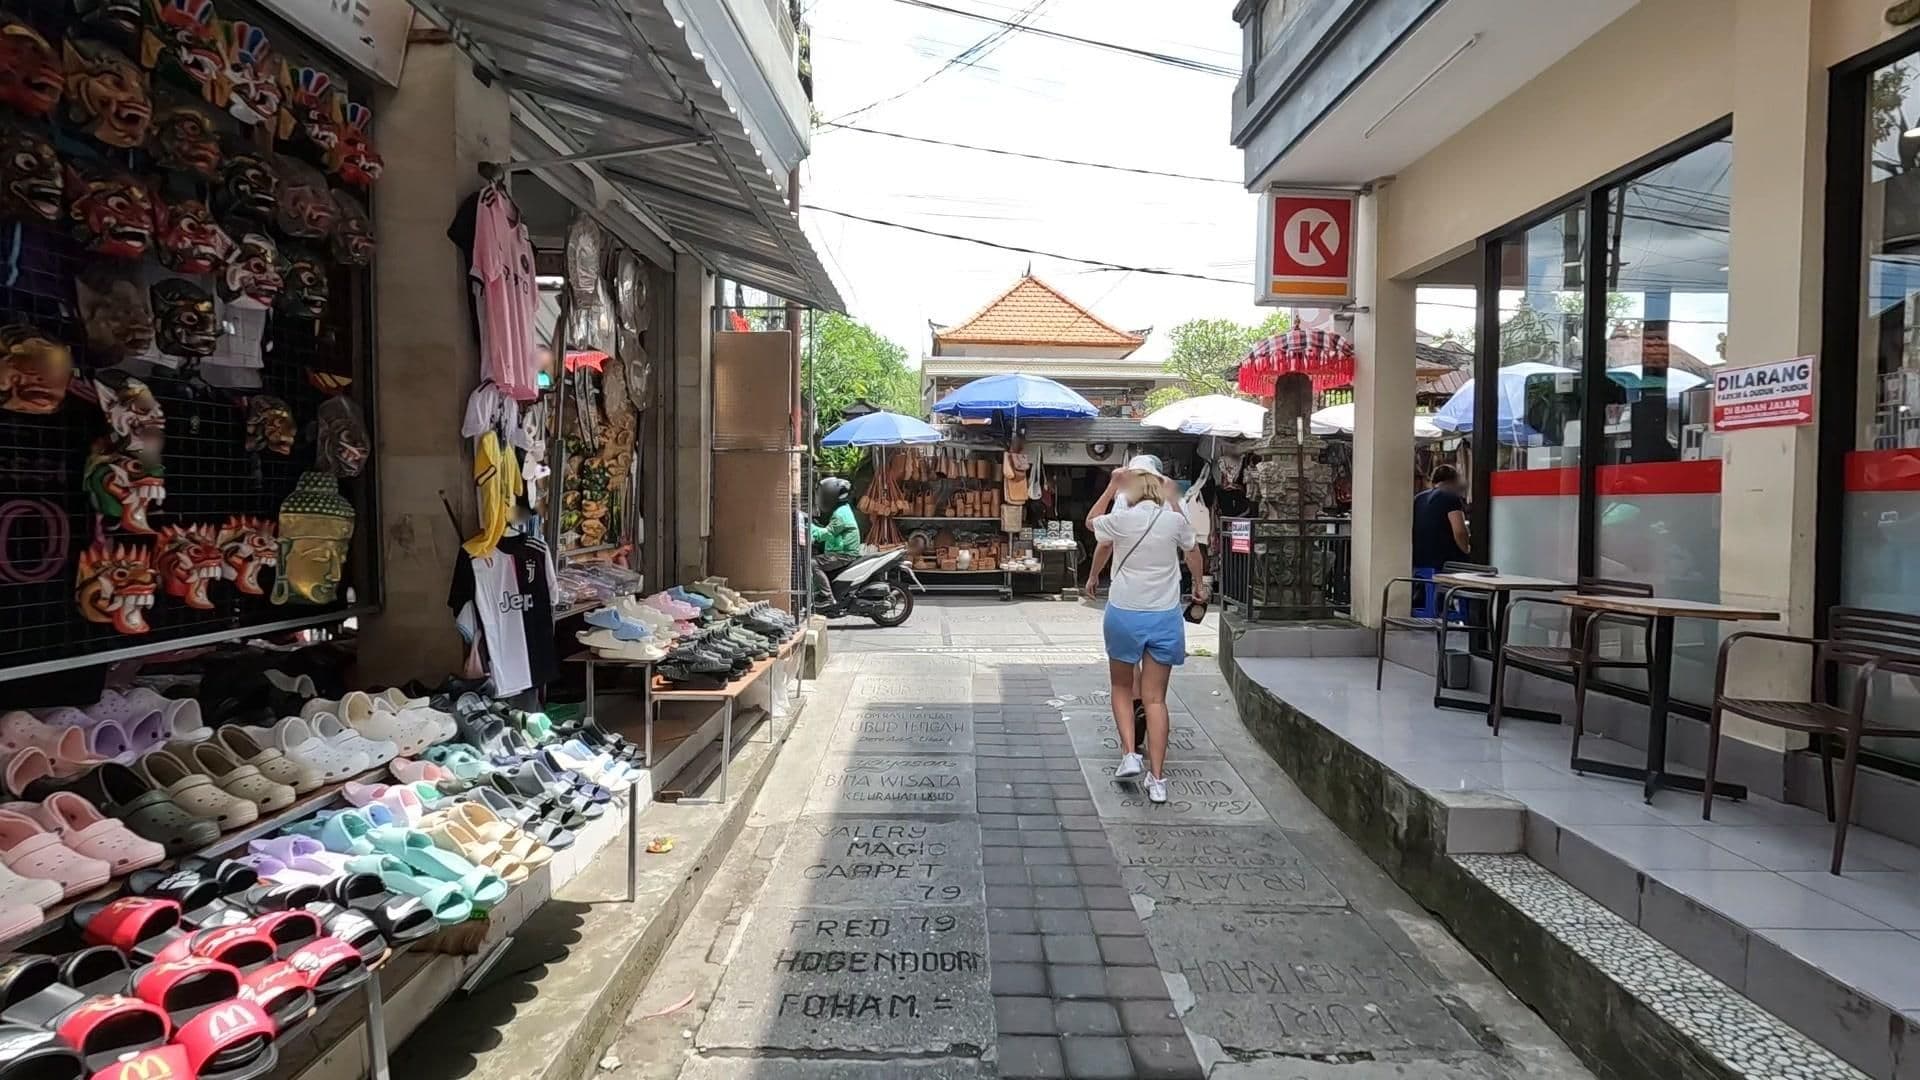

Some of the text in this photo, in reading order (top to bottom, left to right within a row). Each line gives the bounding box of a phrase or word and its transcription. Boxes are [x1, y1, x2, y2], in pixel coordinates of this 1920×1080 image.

[1718, 364, 1810, 391] DILARANG
[880, 774, 961, 787] WISATA
[815, 826, 927, 839] VALERY
[846, 841, 947, 857] MAGIC
[803, 862, 946, 879] CARPET
[917, 885, 961, 900] 79
[790, 915, 957, 937] FRED 79
